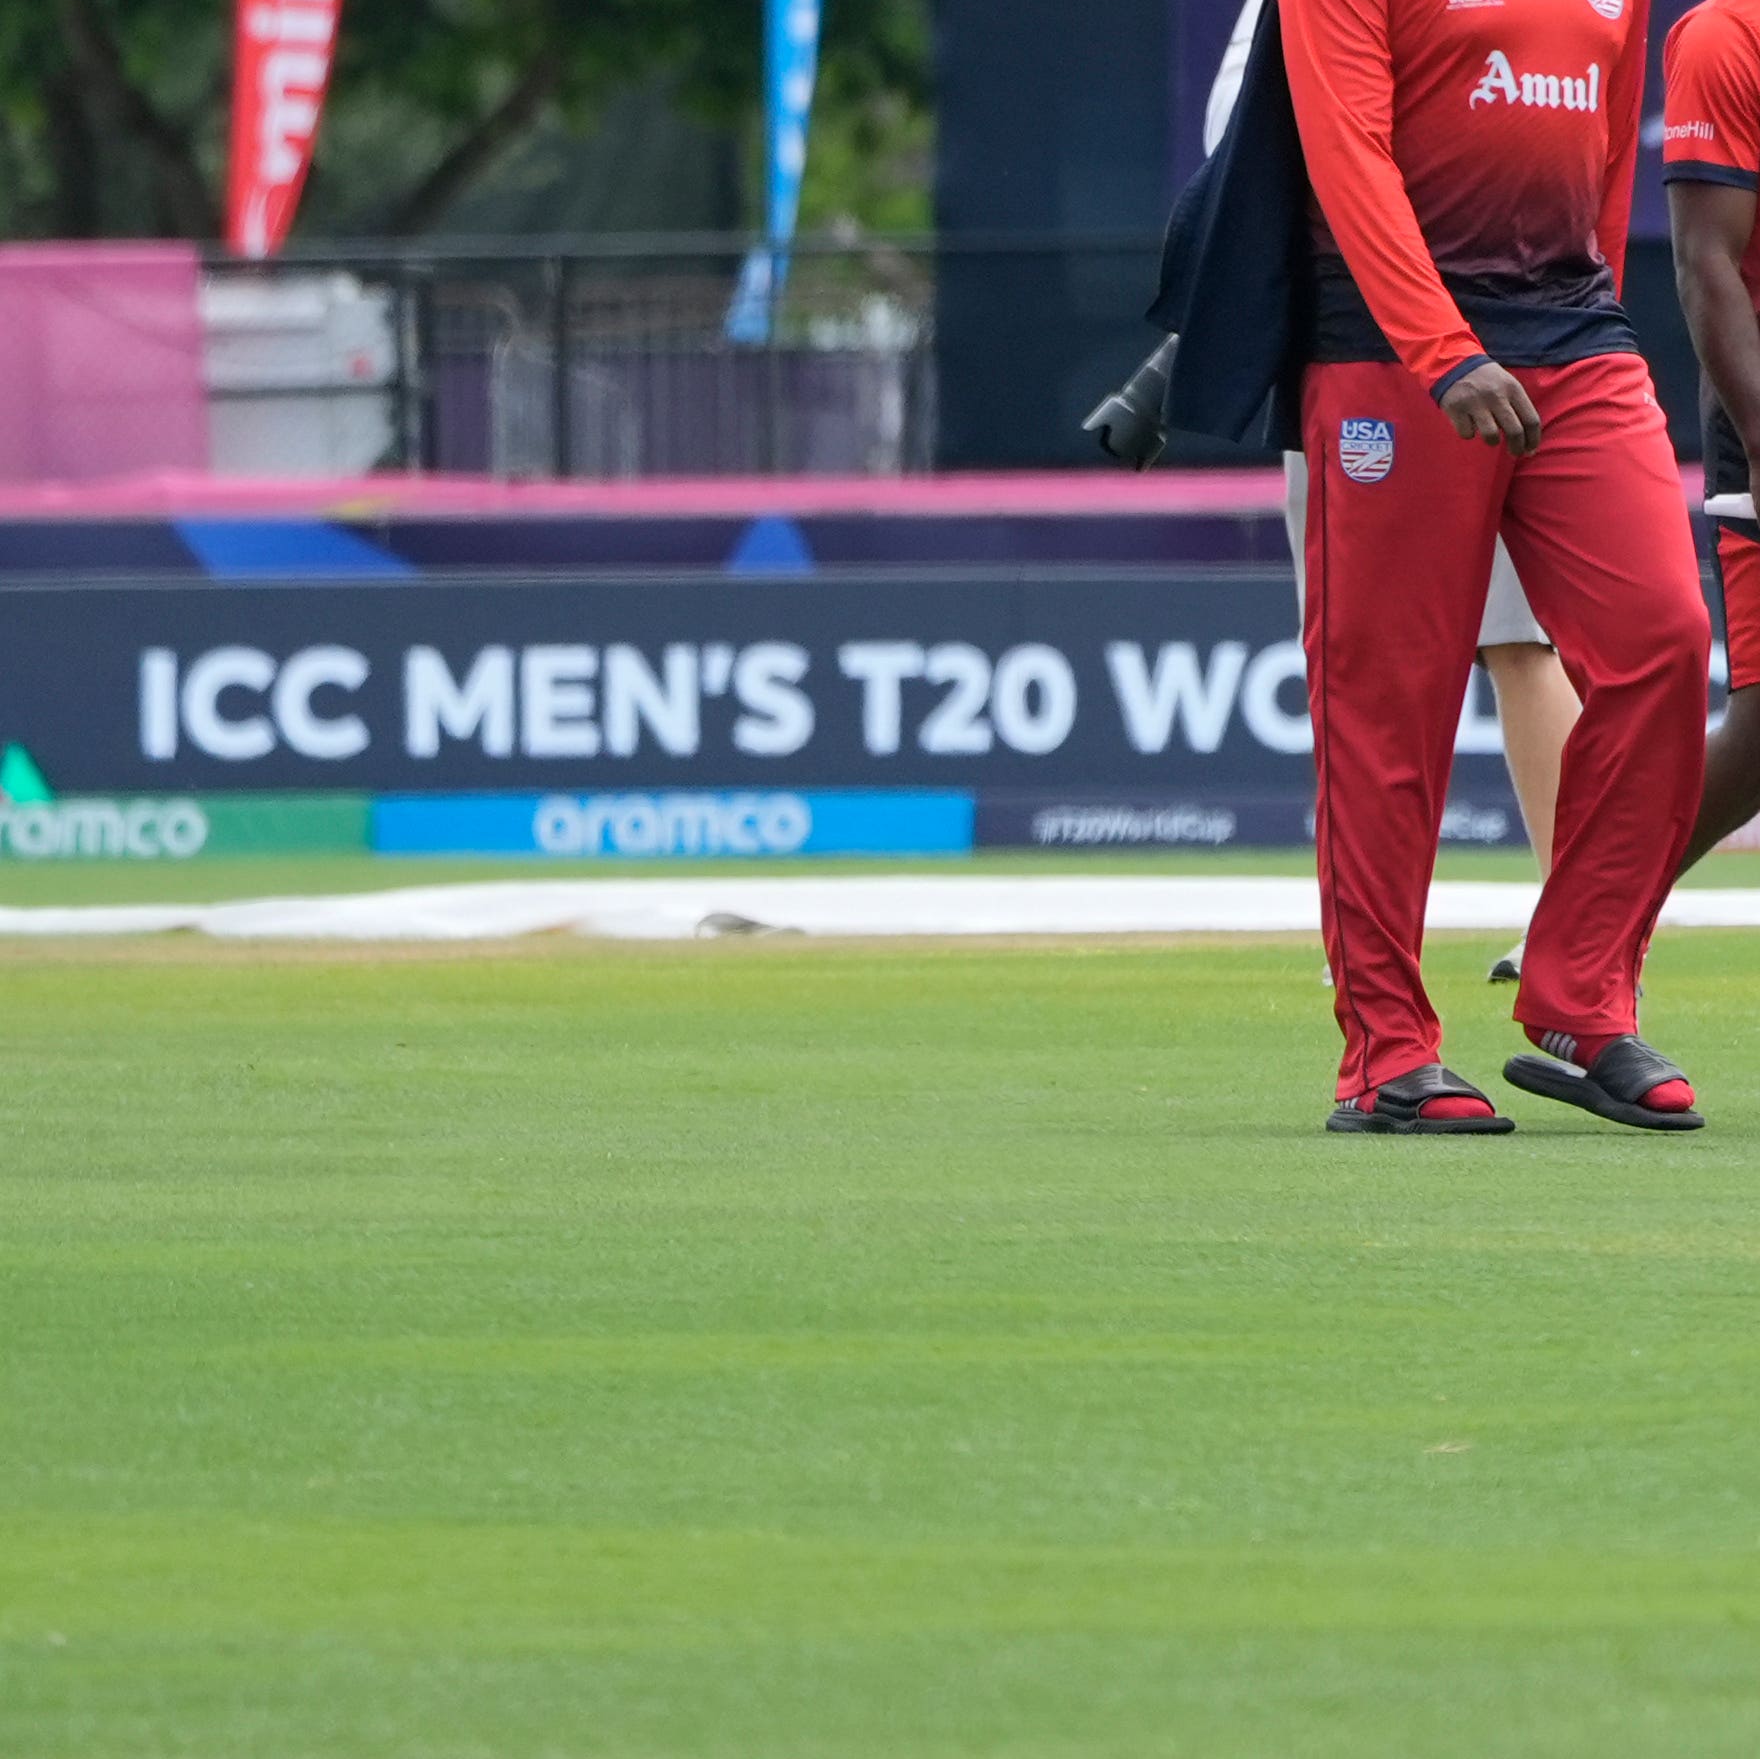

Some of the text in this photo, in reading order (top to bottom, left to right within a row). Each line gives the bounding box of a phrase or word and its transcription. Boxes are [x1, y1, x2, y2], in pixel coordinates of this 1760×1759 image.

[1469, 49, 1600, 113] Amul
[1342, 420, 1391, 440] USA
[138, 644, 371, 761] ICC
[405, 641, 817, 760] MEN'S
[839, 640, 1078, 757] T20
[0, 797, 209, 857] amco
[533, 792, 813, 857] aramco
